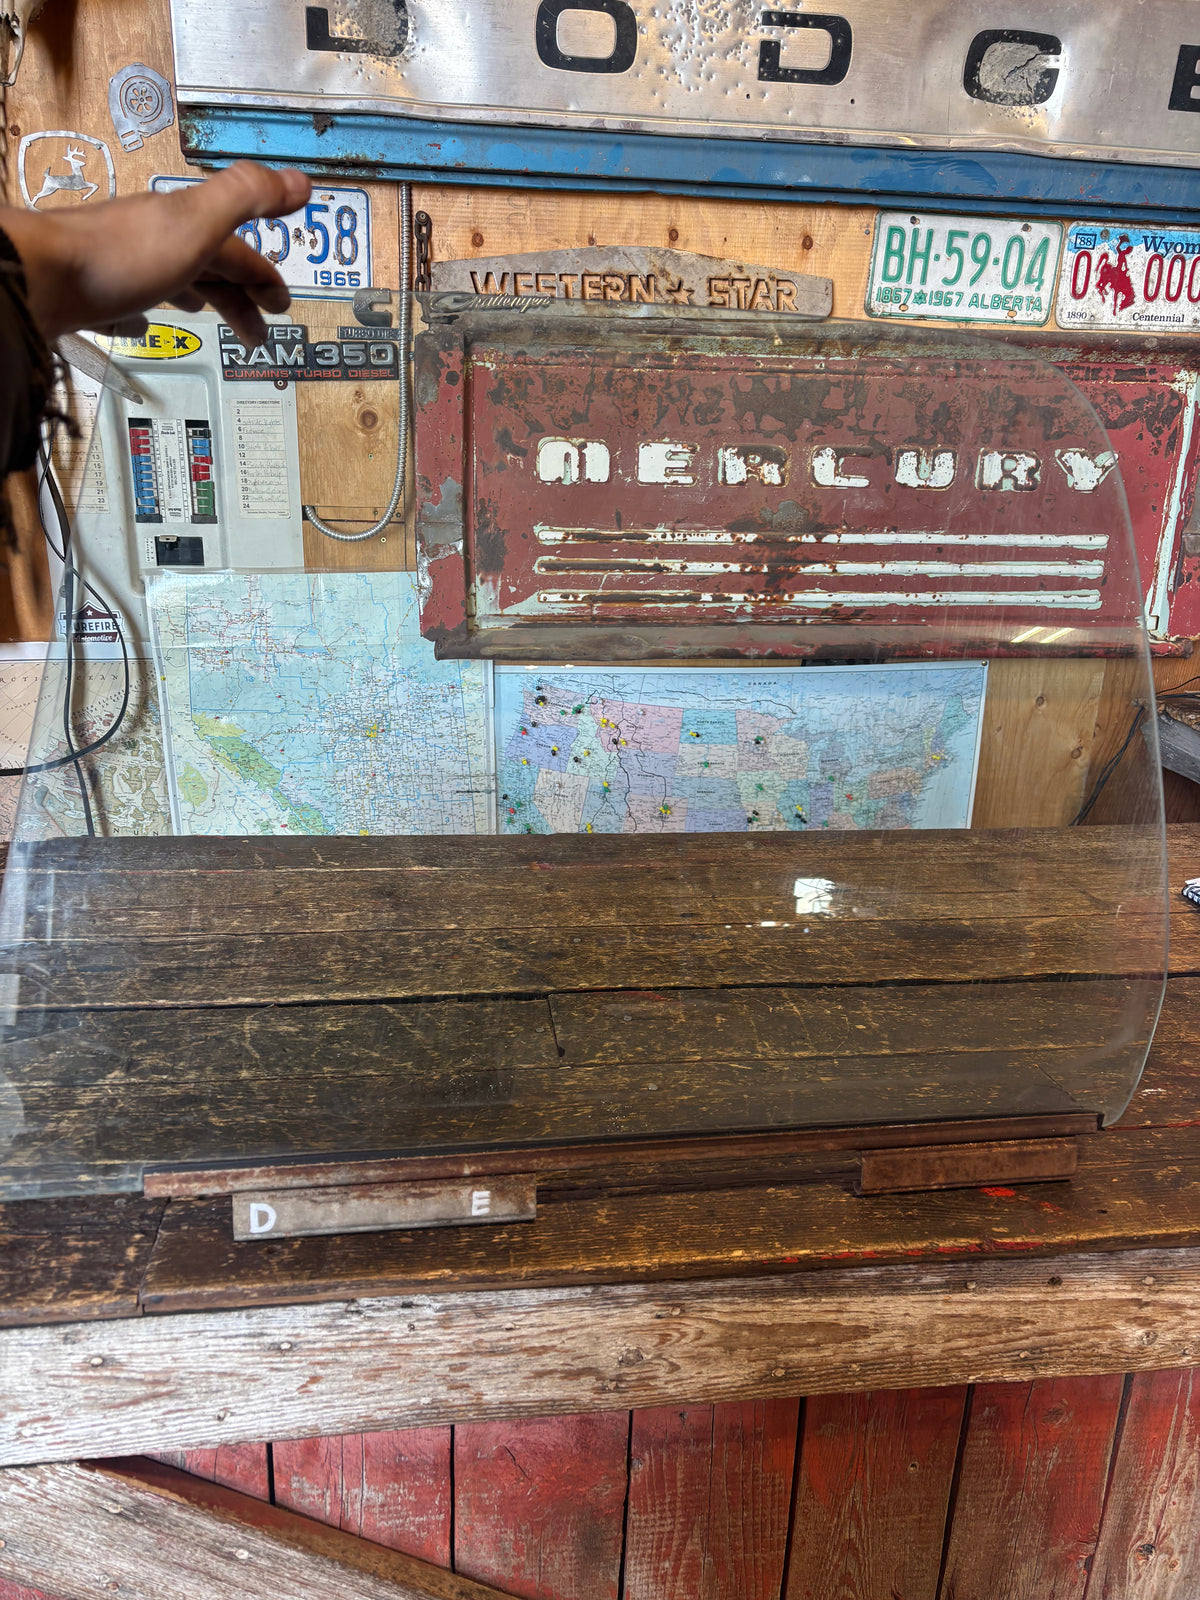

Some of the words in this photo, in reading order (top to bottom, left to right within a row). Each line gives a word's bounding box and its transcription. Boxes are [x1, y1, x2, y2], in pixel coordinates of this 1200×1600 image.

[313, 270, 360, 287] 1966
[705, 276, 799, 311] STAR
[876, 286, 913, 304] 1867
[928, 290, 964, 307] 1967
[968, 293, 1042, 312] ALBERTA
[1066, 311, 1087, 319] 1890
[1132, 312, 1185, 322] Centennial
[220, 326, 304, 341] PER
[222, 343, 306, 367] RAM
[315, 344, 395, 367] 350
[295, 369, 342, 379] TURBO
[348, 370, 395, 379] DIESEL
[535, 436, 1118, 493] MERCURY
[74, 621, 118, 632] UREFIRE
